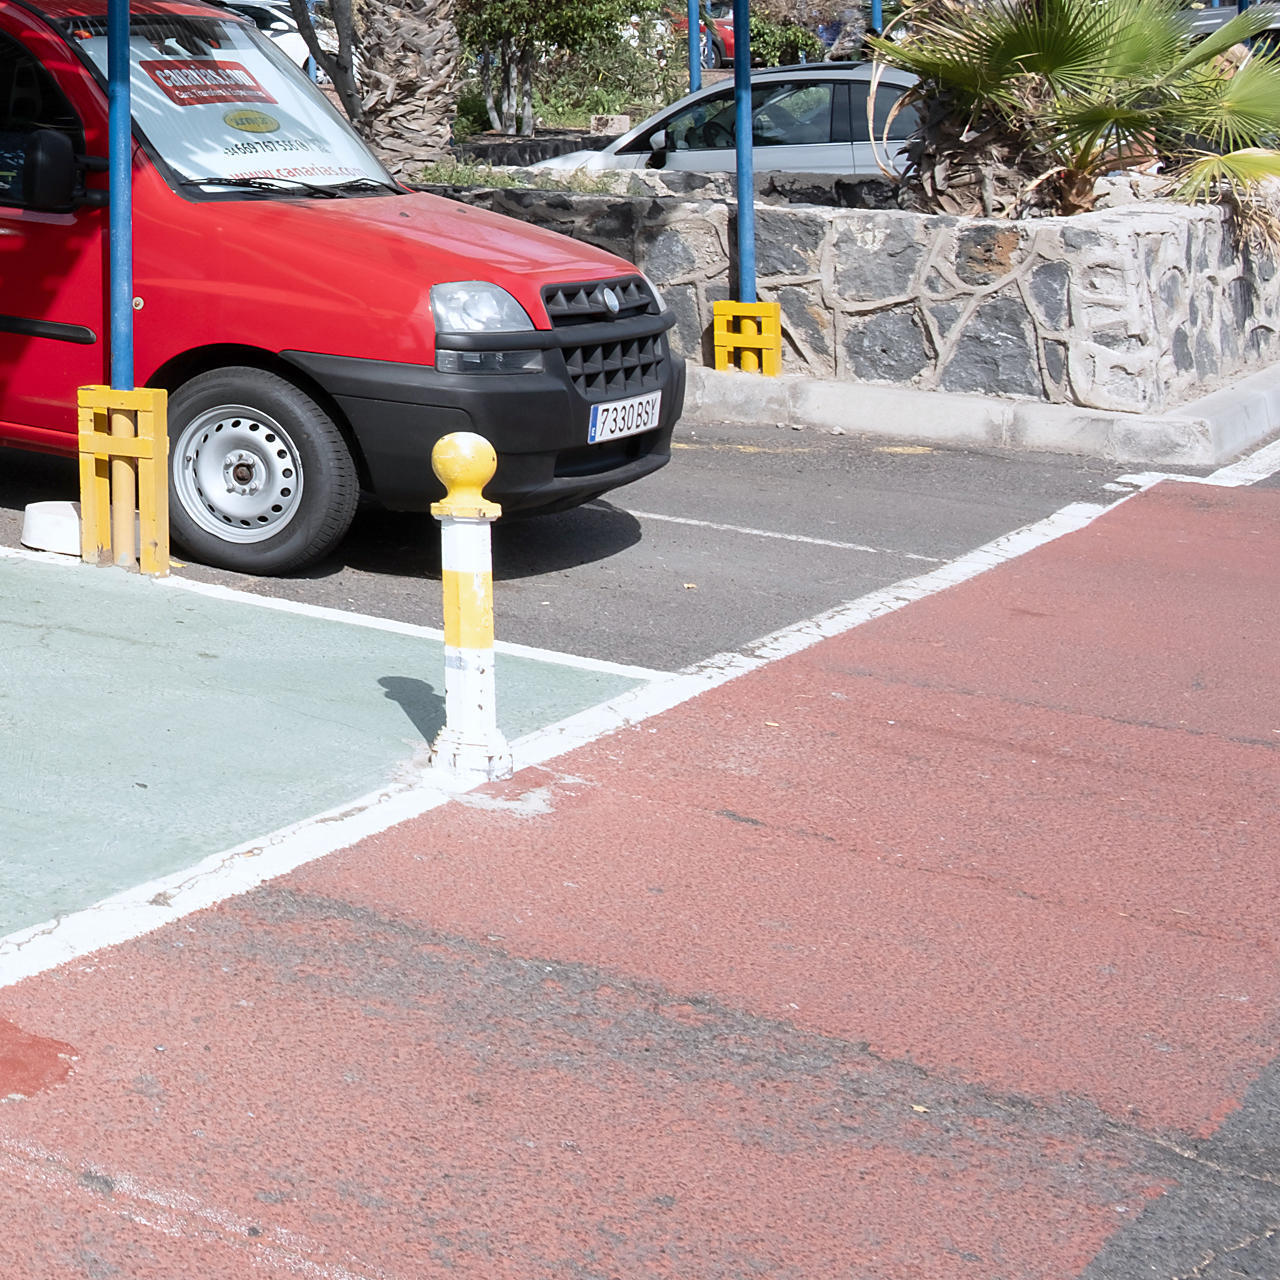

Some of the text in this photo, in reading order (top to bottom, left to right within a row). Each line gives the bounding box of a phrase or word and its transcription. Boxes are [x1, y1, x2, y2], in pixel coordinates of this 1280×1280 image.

[155, 65, 257, 87] canarias.com
[234, 142, 259, 154] 669
[255, 140, 279, 153] 767
[229, 163, 370, 180] www.canarias.com
[600, 405, 635, 437] 7330
[636, 398, 657, 428] BSY
